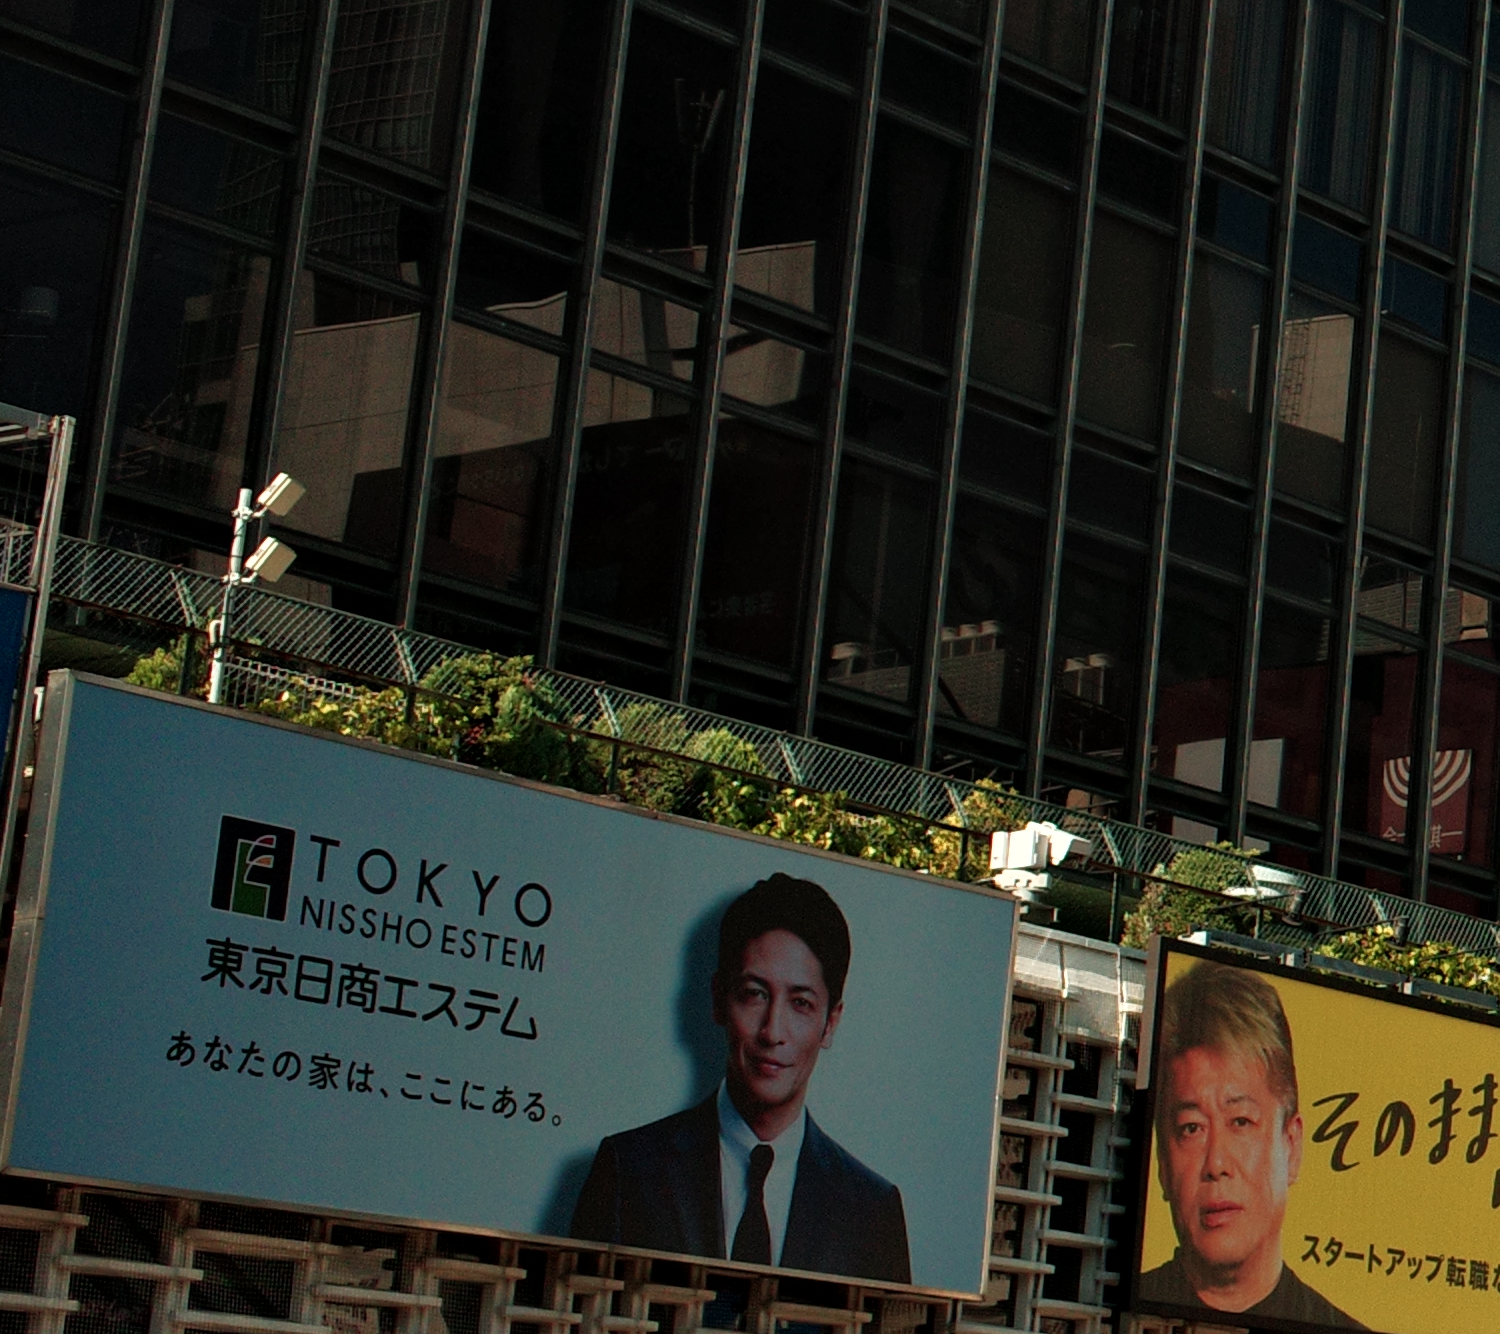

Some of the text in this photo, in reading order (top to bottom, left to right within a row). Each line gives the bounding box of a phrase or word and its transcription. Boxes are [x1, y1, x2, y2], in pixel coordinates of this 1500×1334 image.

[309, 834, 554, 927] TOKYO
[300, 894, 545, 973] NISSHO ESTEM
[201, 937, 538, 1040] 東京日商エステム
[165, 1029, 567, 1126] あなたの家は、ここにある。
